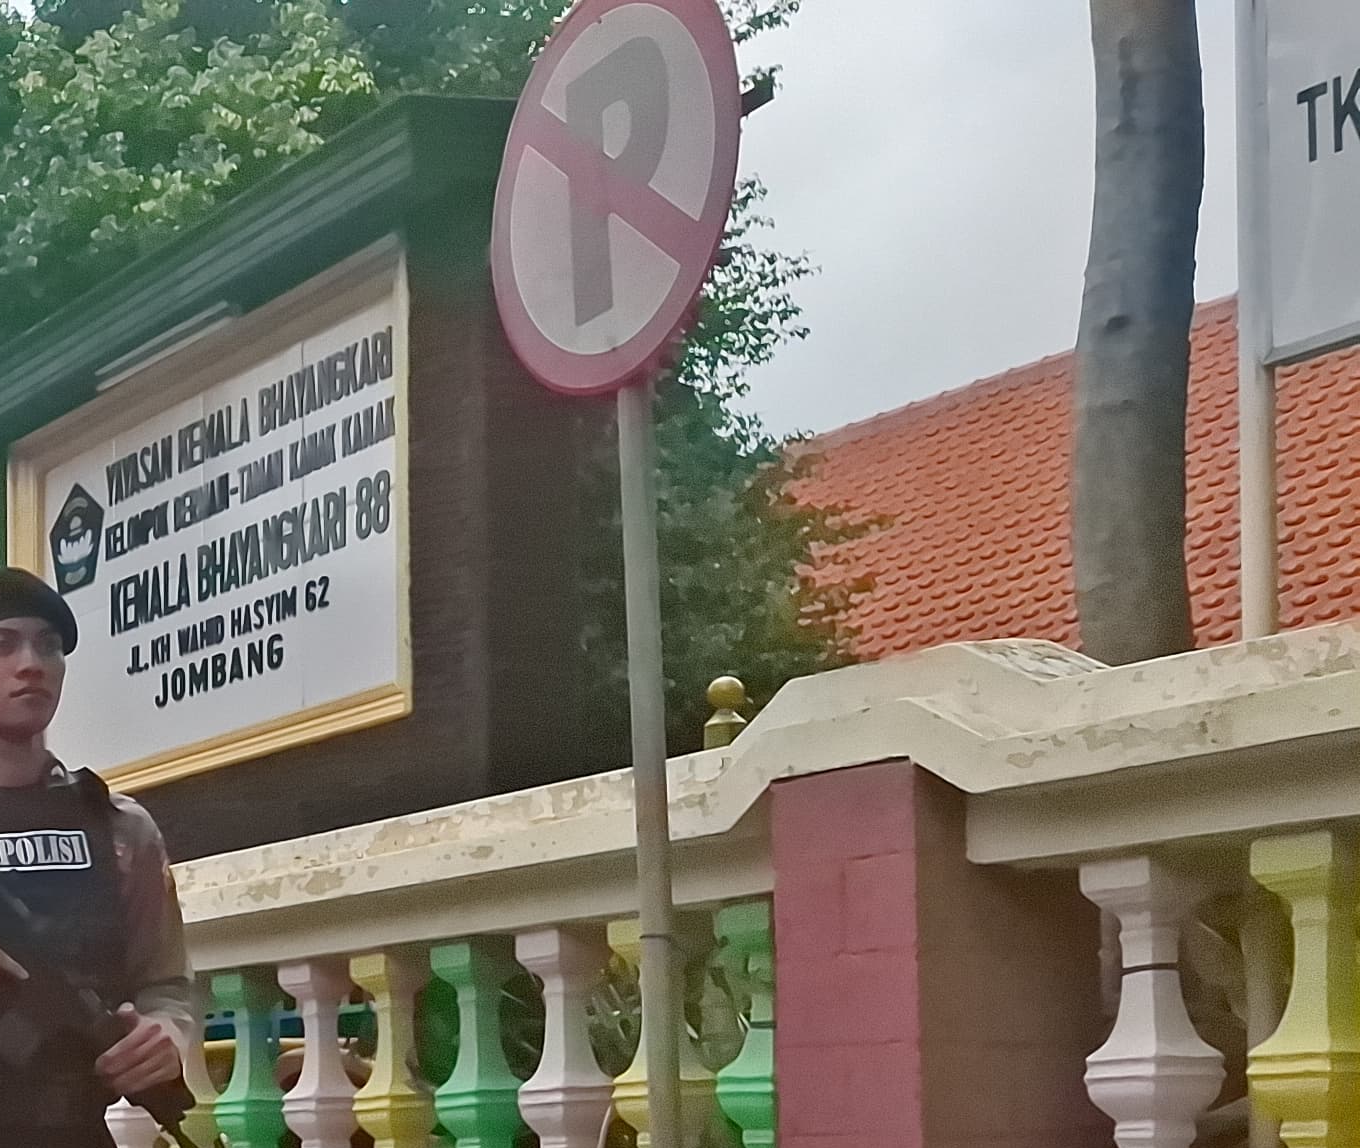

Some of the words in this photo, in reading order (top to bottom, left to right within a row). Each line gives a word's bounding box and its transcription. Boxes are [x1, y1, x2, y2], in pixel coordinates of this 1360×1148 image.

[105, 500, 169, 561] KELOMPOK
[289, 423, 336, 482] KANAK
[342, 395, 395, 458] KANAK
[106, 434, 173, 507] YAYASAN
[178, 397, 250, 474] KEMALA
[258, 325, 393, 437] BHAYANGKARI
[110, 553, 190, 636] KEMALA
[197, 486, 346, 602] BHAYANGKARI
[356, 470, 390, 540] 88
[178, 615, 224, 656] WAHID
[231, 586, 297, 637] HASYIM
[305, 575, 330, 612] 62
[155, 634, 283, 708] JOMBANG
